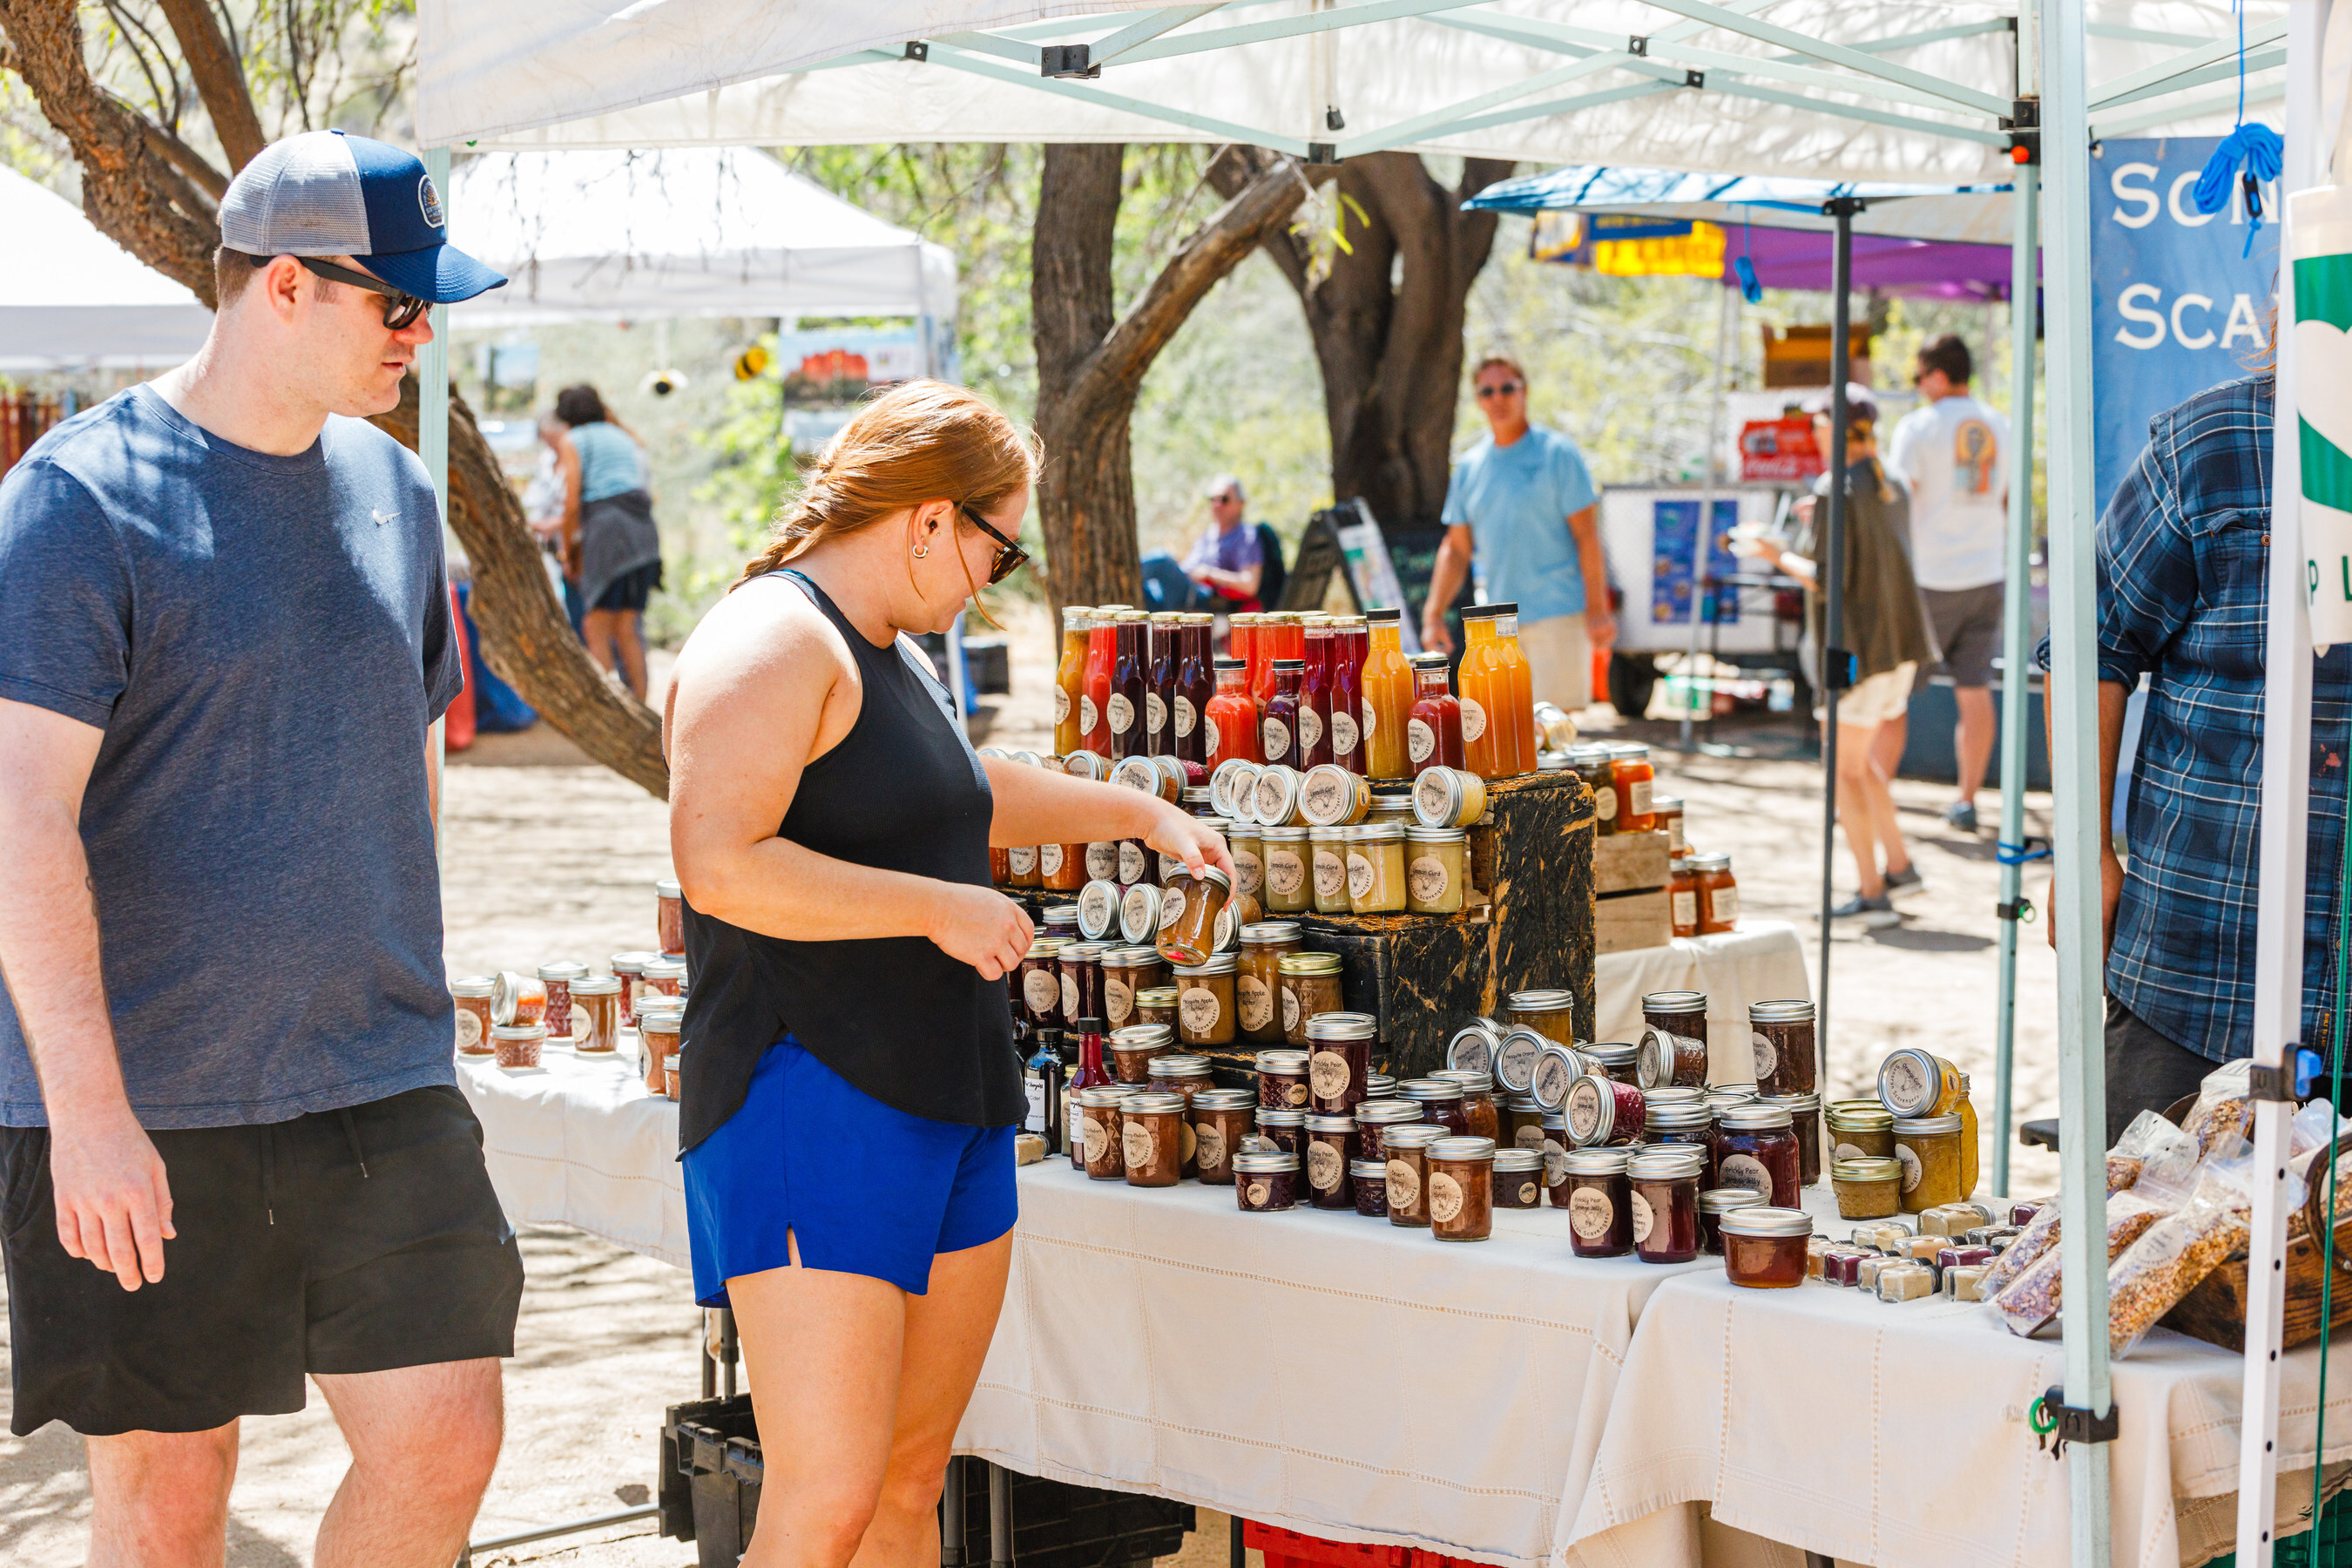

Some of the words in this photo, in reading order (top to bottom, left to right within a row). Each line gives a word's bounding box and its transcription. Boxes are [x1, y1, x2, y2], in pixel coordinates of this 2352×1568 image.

[2114, 283, 2280, 350] SCA
[1310, 788, 1325, 797] Lemon
[1425, 782, 1437, 793] Lemon
[1436, 787, 1447, 797] Curd
[1238, 874, 1263, 894] Scavengers
[1277, 874, 1302, 893] Scavengers
[1320, 875, 1344, 895] Scavengers
[1418, 882, 1446, 900] Scavengers
[1036, 988, 1058, 1011] Scavengers
[1193, 1008, 1218, 1031] Scavengers
[1246, 1003, 1271, 1029] Scavengers
[1321, 1075, 1348, 1097] Scavengers
[1890, 1064, 1900, 1090] Sonoran
[1902, 1062, 1915, 1079] Orange
[1913, 1077, 1923, 1090] Curd
[1892, 1090, 1920, 1105] Scavengers
[1129, 1145, 1150, 1166] Scavengers
[1200, 1146, 1222, 1168] Scavengers
[1315, 1165, 1340, 1187] Scavengers
[1725, 1166, 1745, 1176] Prickly
[1392, 1186, 1417, 1206] Scavengers
[1574, 1196, 1589, 1205] Prickly
[1437, 1195, 1462, 1220] Scavengers
[1583, 1212, 1610, 1237] Scavengers
